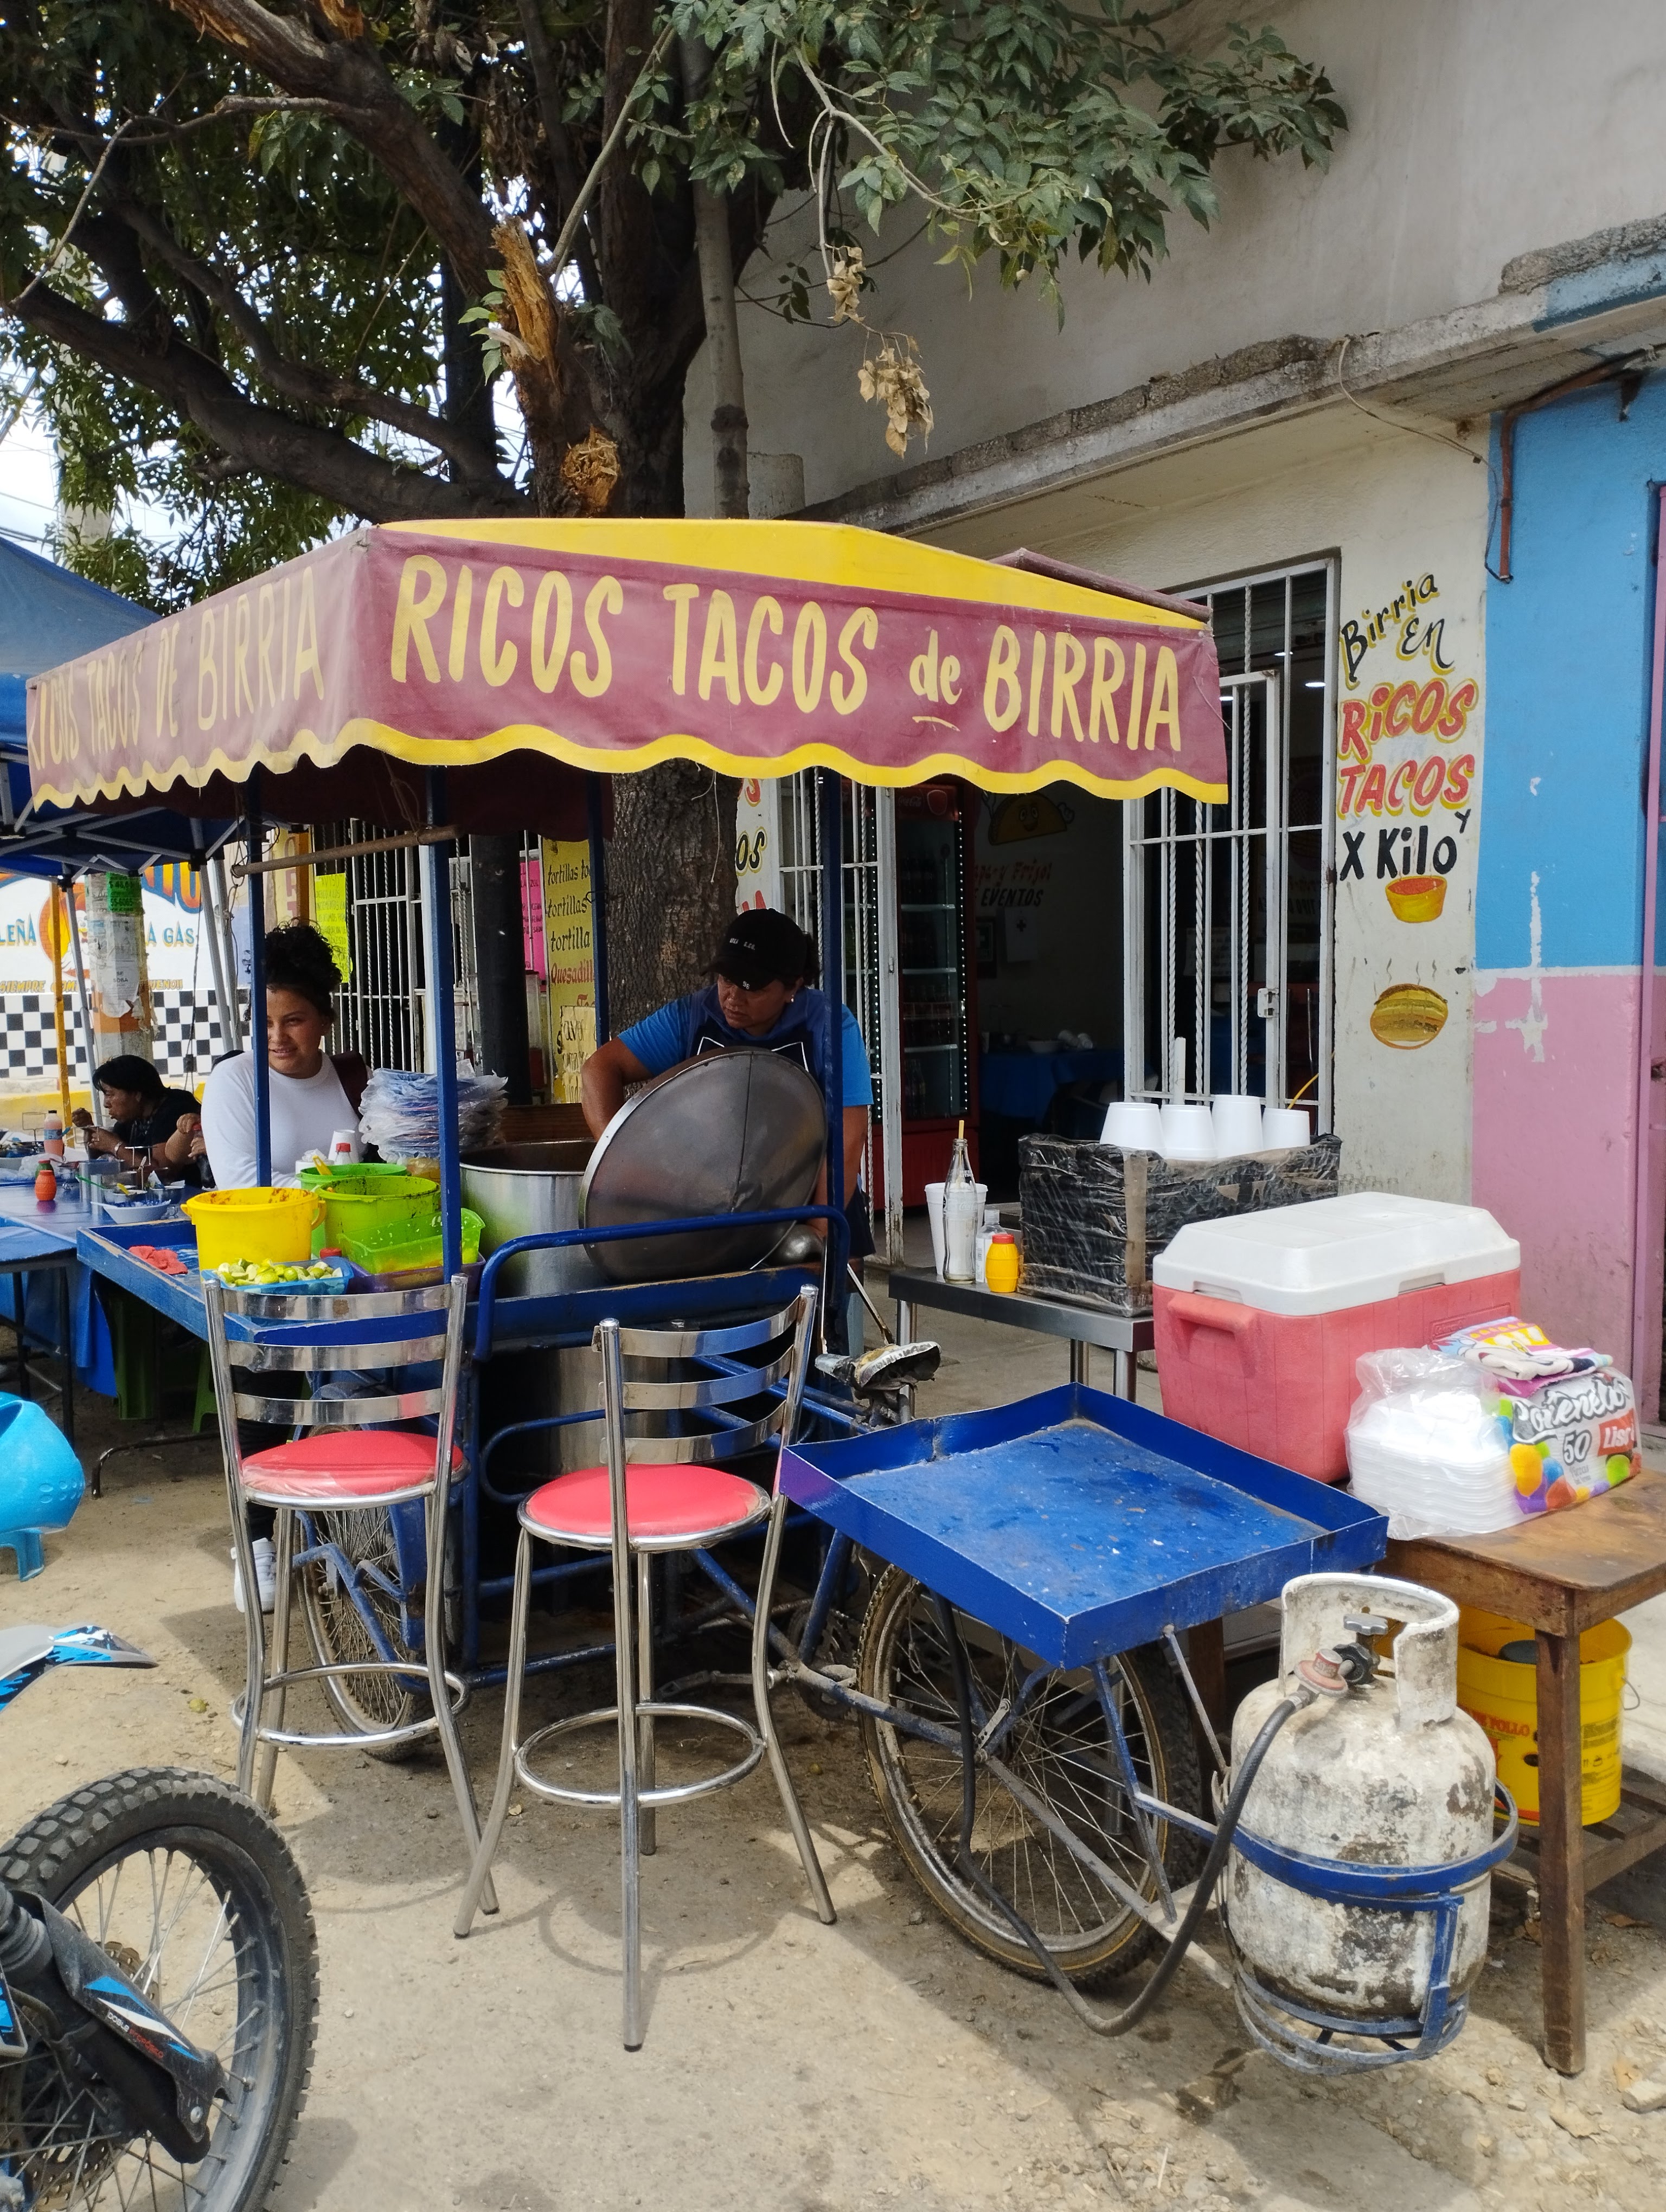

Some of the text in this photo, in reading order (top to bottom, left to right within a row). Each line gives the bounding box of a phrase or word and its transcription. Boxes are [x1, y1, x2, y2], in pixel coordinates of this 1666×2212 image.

[1340, 573, 1439, 686] Birria
[87, 640, 144, 757] TACOS
[156, 621, 181, 738] DE
[198, 566, 324, 731] BIRRIA
[390, 555, 1181, 751] RICOS TACOS de BIRRIA
[1337, 753, 1476, 818] TACOS
[1340, 825, 1458, 882] X Kilo
[548, 864, 578, 886] tortillas
[548, 895, 587, 918] tortillas
[983, 888, 1044, 908] EVENTOS
[163, 921, 195, 947] GAS
[0, 979, 46, 994] SIEMPRE
[550, 959, 594, 985] Quesadill
[1562, 1429, 1592, 1467] 50
